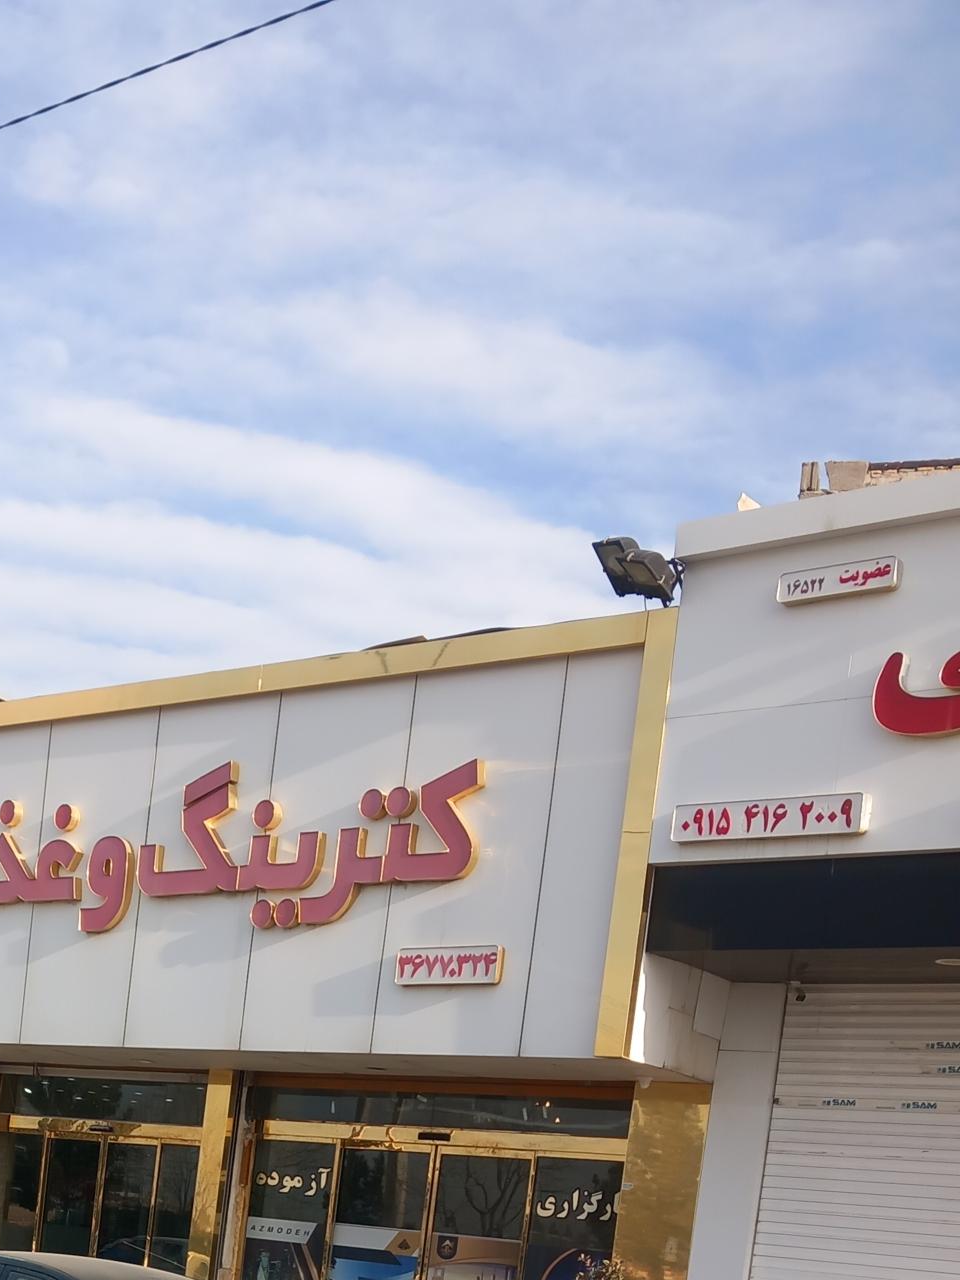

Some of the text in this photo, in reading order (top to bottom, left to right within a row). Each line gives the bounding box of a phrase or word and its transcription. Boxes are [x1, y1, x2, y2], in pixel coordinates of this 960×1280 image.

[838, 562, 891, 586] عضویت
[681, 798, 853, 836] ۰۹۱۵ ۴۱۶ ۲۰۰۹
[138, 758, 486, 930] کترینگ
[255, 1167, 332, 1197] آزموده
[536, 1188, 621, 1221] ارگزاری
[250, 1224, 311, 1237] AZMODEH
